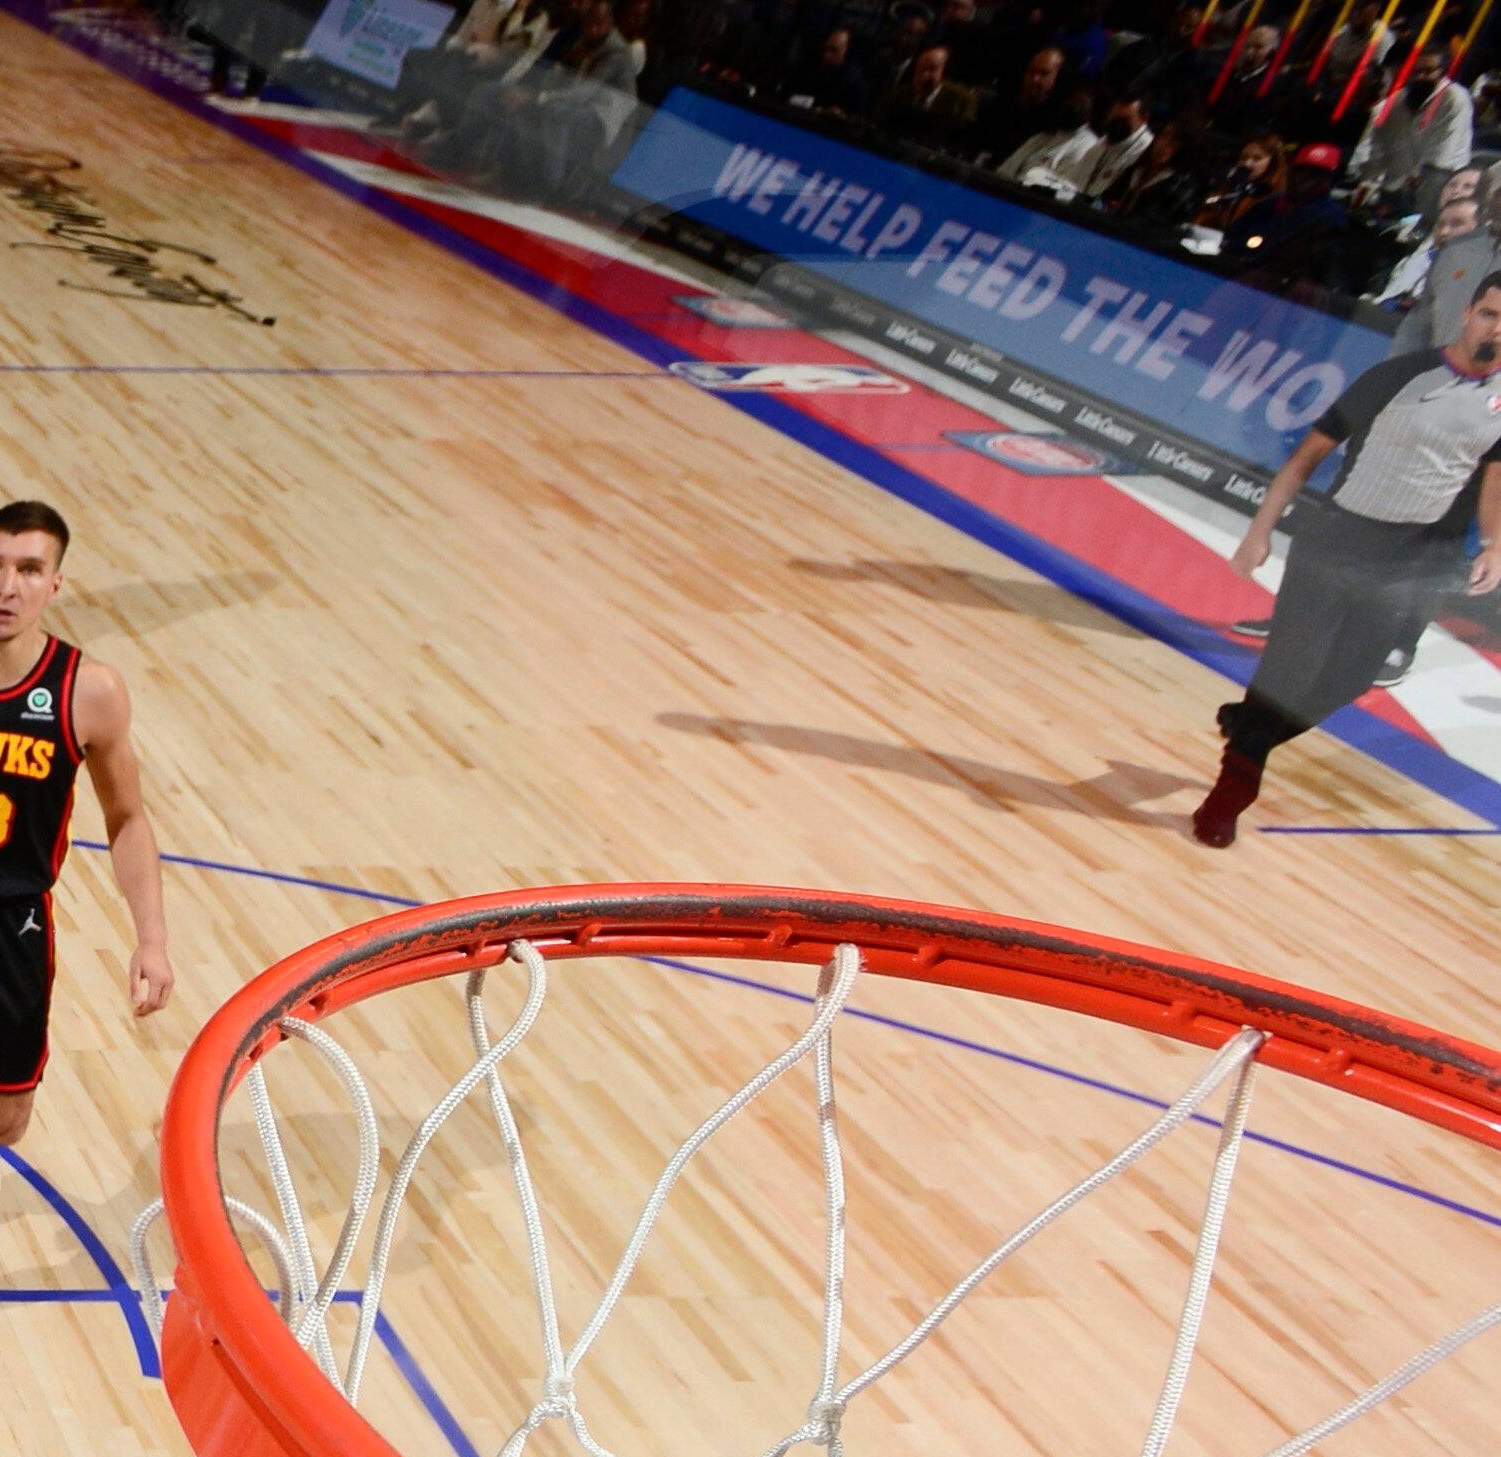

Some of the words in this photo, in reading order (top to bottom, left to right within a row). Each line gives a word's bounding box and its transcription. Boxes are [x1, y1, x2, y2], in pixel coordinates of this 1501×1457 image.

[712, 142, 799, 216] WE
[780, 167, 922, 261] HELP
[906, 223, 1067, 320] FEED
[1059, 276, 1213, 383] THE
